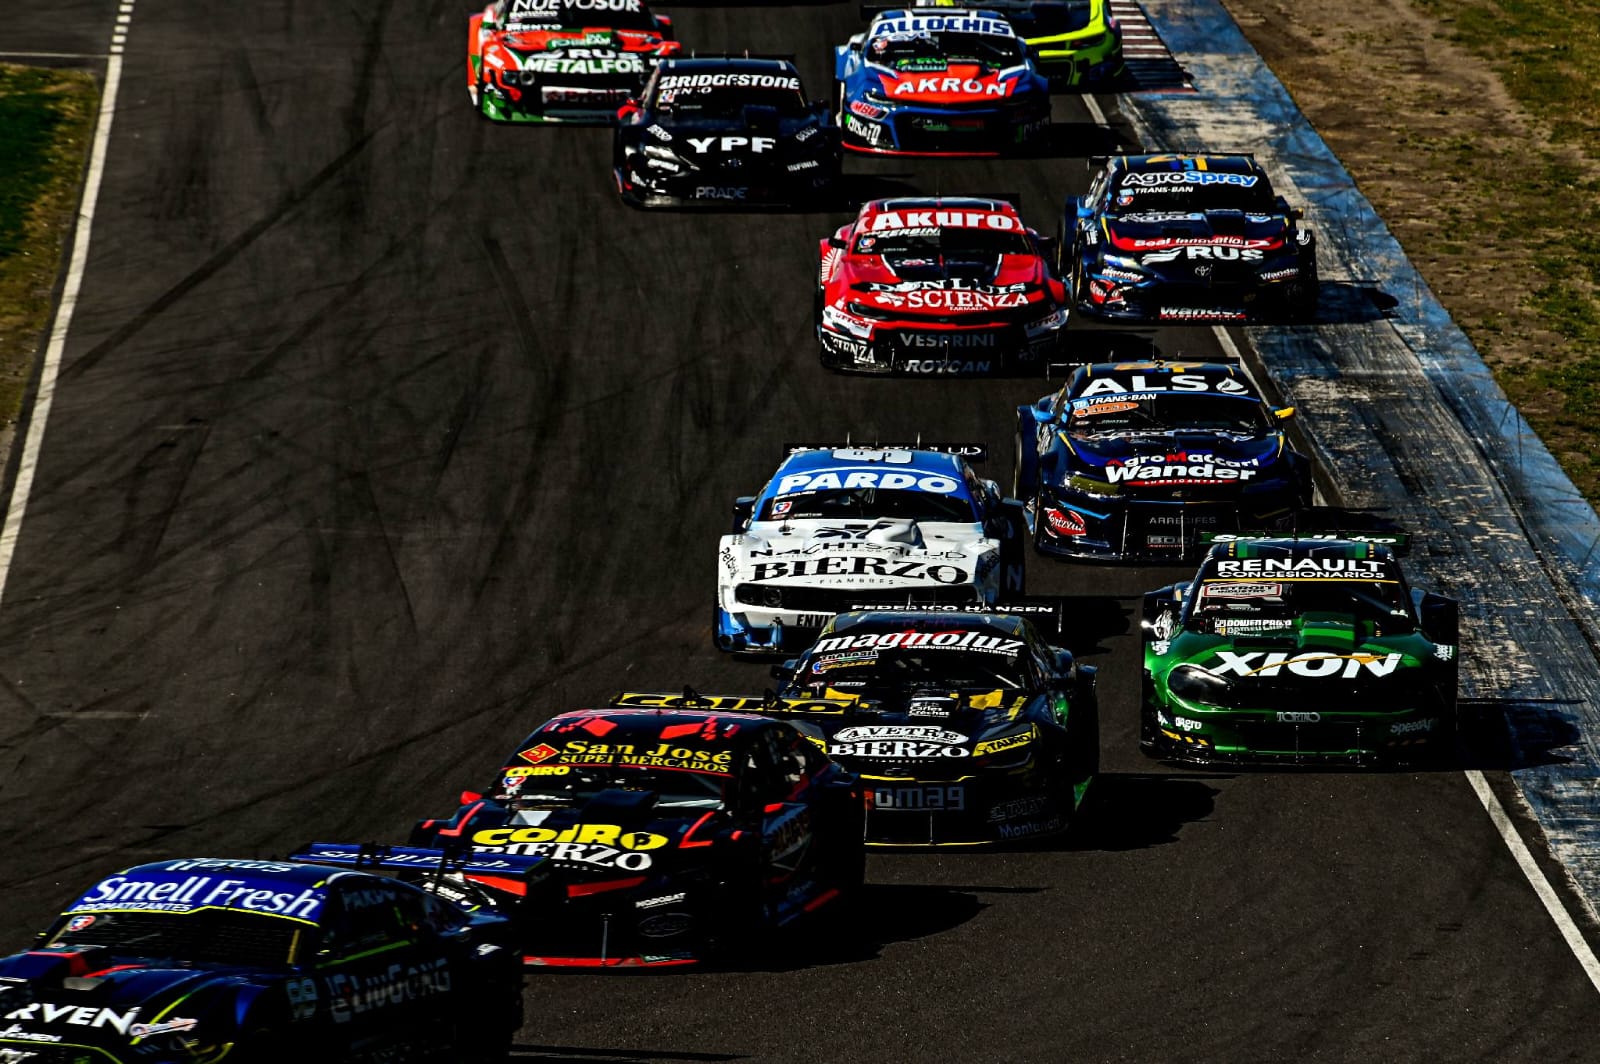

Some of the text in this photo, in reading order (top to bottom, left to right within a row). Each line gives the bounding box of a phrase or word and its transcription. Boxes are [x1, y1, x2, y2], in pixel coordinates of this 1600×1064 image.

[523, 58, 646, 74] METALFOR
[661, 86, 712, 97] DENO
[895, 77, 1007, 97] AKRON
[686, 136, 776, 154] YPF
[1121, 170, 1259, 188] AgroSpray
[1134, 186, 1193, 194] TRANS-BAN
[907, 291, 1029, 308] SCIENZA
[900, 332, 994, 347] VESPRINI
[1090, 394, 1157, 405] TRANS-BAN
[1104, 464, 1257, 484] Wander
[777, 473, 958, 496] PARDO
[749, 557, 970, 585] BIERZO
[1217, 558, 1386, 573] RENAULT
[1217, 571, 1386, 579] CONCESIONARIOS
[1211, 651, 1403, 679] XION
[563, 741, 732, 769] San José
[828, 741, 970, 758] BIERZO
[84, 876, 322, 919] Smell Fresh
